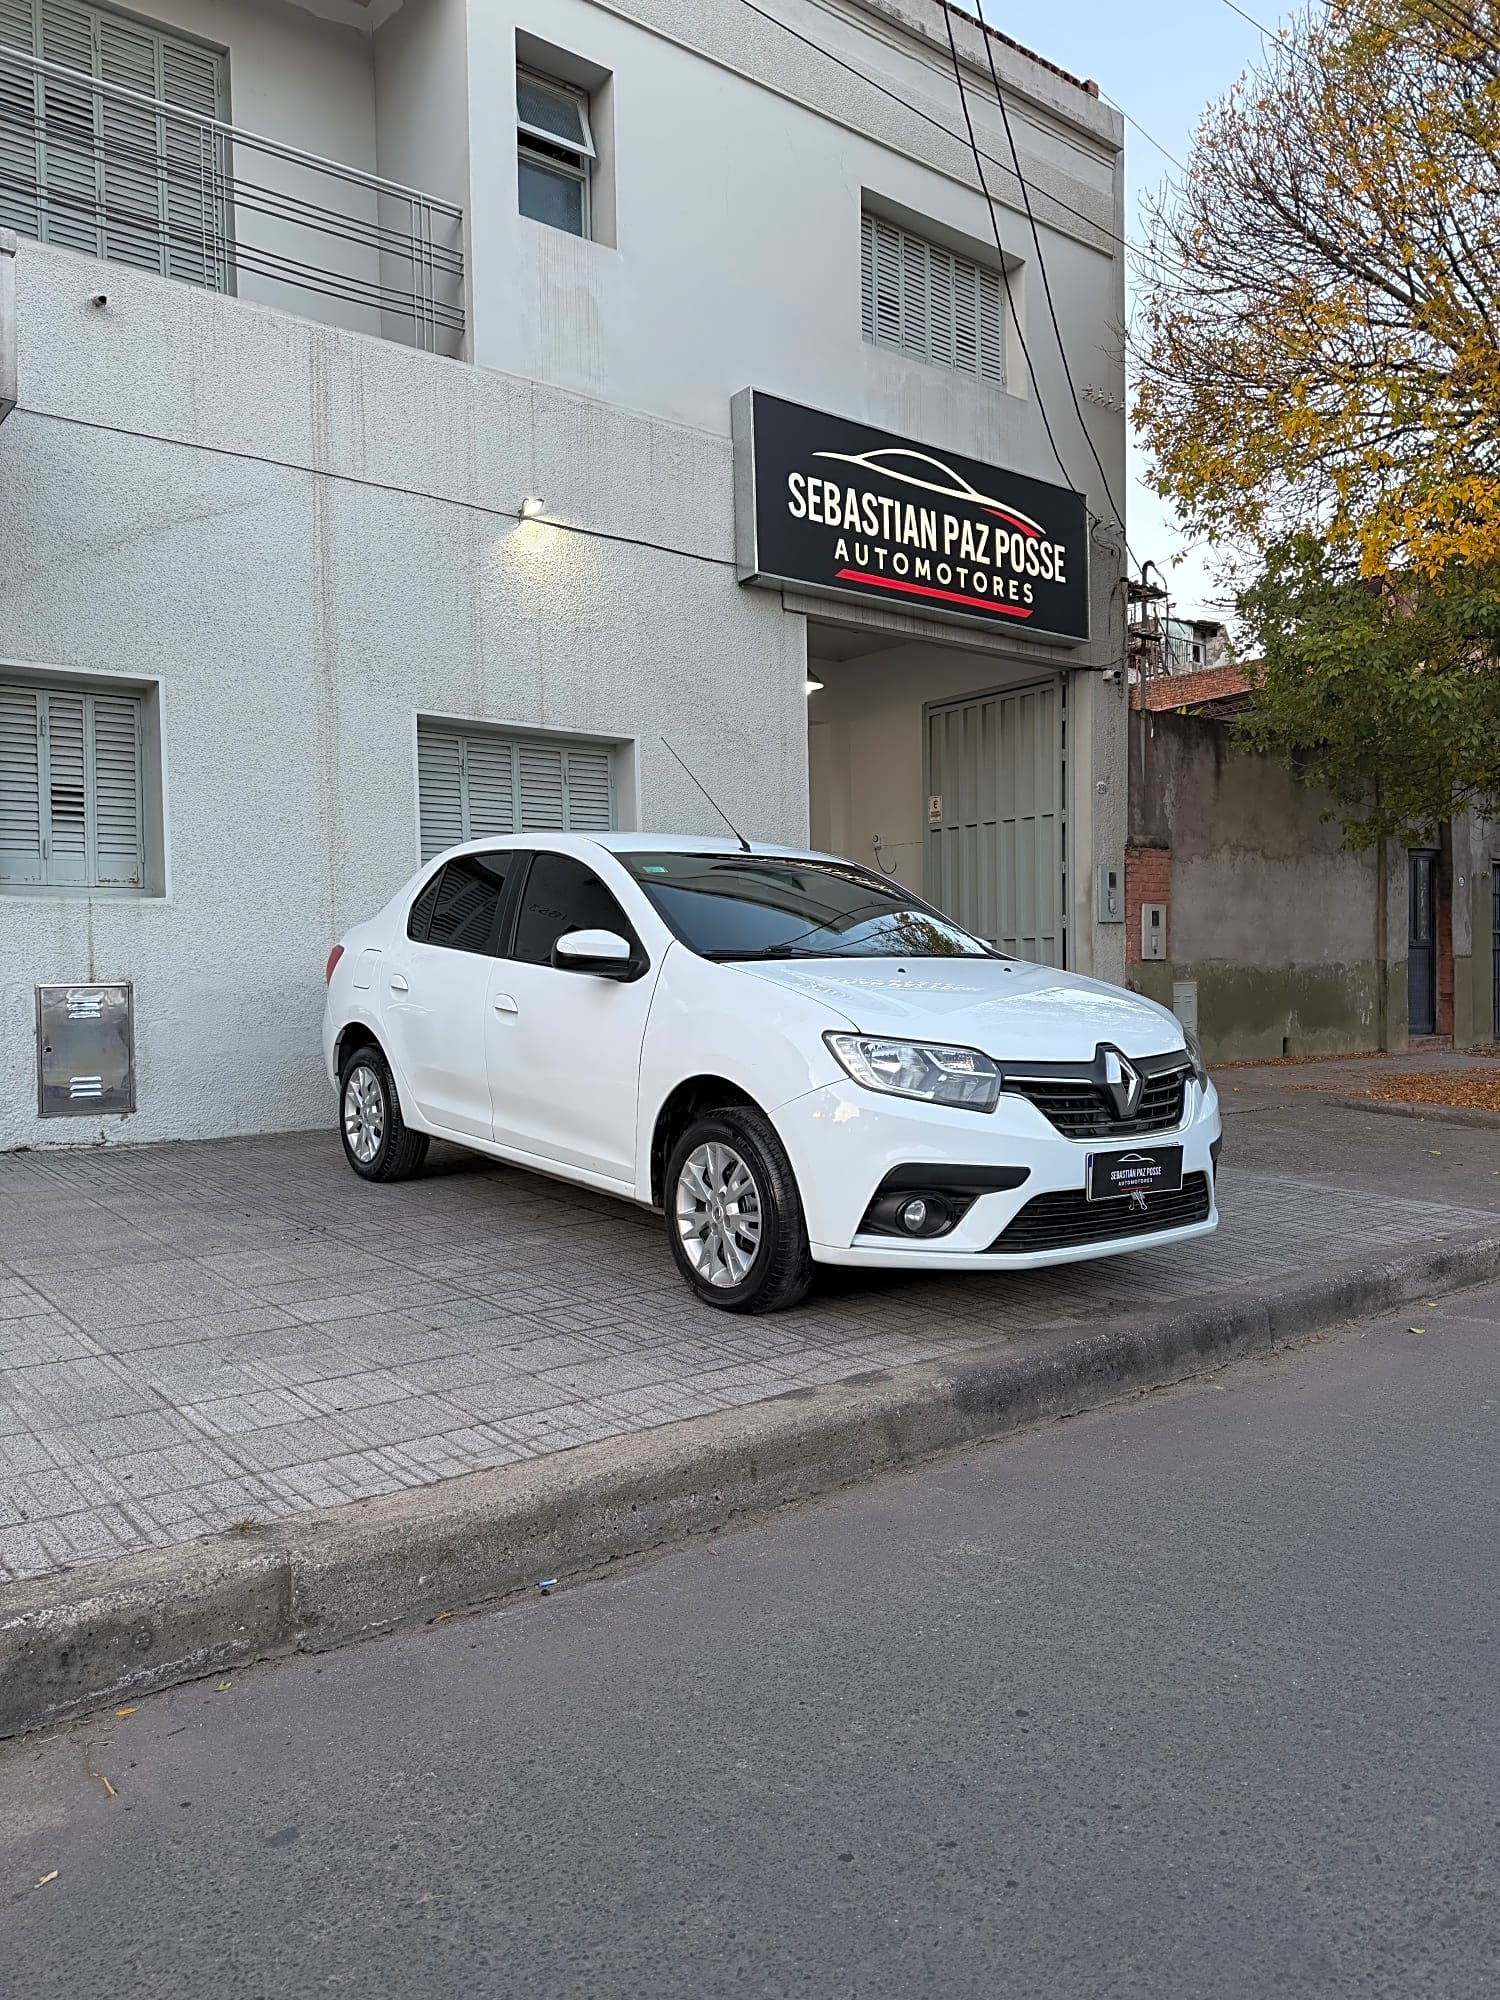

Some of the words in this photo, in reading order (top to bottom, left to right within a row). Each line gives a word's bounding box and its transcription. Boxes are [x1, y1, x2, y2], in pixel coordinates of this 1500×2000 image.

[788, 472, 937, 552] SEBASTIAN
[943, 514, 990, 565] PAZ
[995, 528, 1066, 583] POSSE
[834, 538, 1034, 604] AUTOMOTORES
[1136, 1168, 1146, 1177] PAZ
[1146, 1166, 1162, 1176] POSSE
